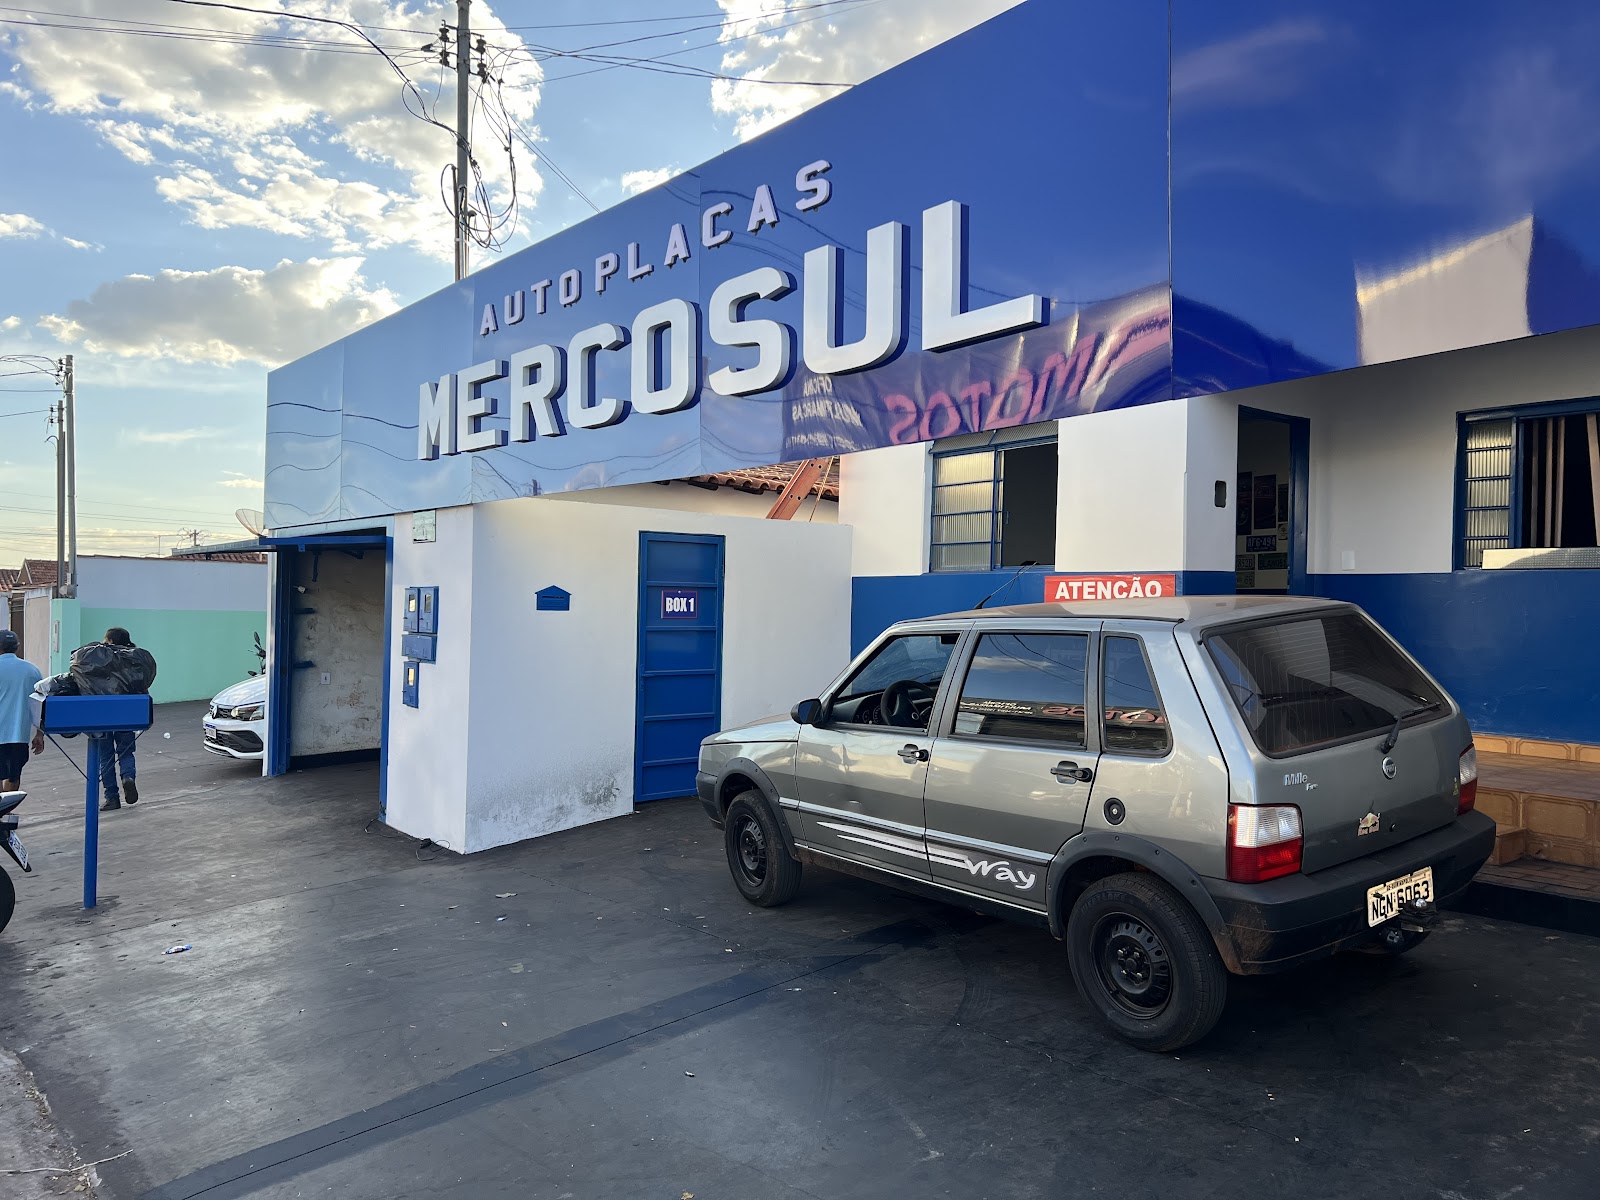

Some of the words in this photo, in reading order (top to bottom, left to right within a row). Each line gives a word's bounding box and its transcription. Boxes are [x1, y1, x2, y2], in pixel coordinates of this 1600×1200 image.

[418, 200, 1051, 462] MERCOSUL
[665, 597, 687, 612] BOX
[688, 597, 695, 612] 1
[1284, 772, 1308, 786] Mille
[964, 858, 1036, 890] Way
[1372, 892, 1394, 921] NGN
[1397, 880, 1430, 909] 6063
